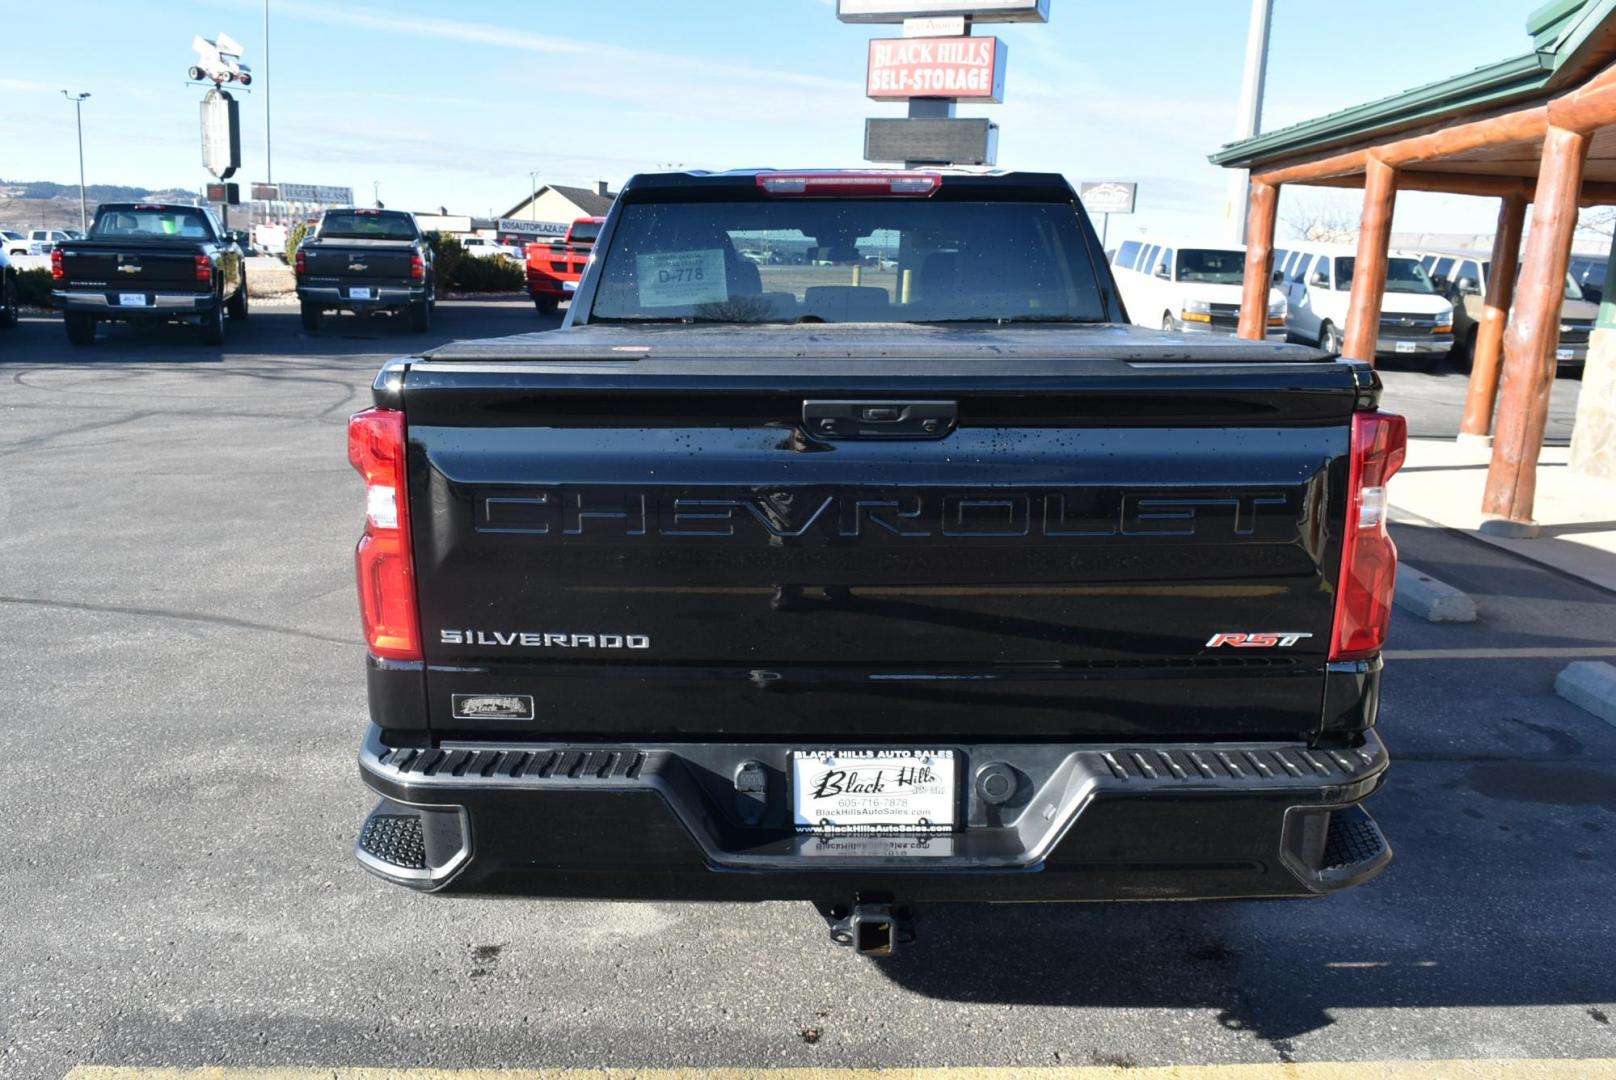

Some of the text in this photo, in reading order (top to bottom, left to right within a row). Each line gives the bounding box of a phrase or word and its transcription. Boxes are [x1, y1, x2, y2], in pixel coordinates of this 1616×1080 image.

[874, 42, 990, 67] BLACK HILLS
[871, 68, 988, 90] SELF-STORAGE
[502, 222, 568, 233] 605AUTOPLAZA.CO
[659, 268, 704, 283] D-778
[474, 494, 1287, 536] CHEVROLET
[440, 629, 650, 649] SILVERADO
[1205, 633, 1313, 647] RST
[794, 750, 954, 759] BLACK HILLS AUTO SALES
[808, 766, 936, 799] Black Hills
[838, 798, 908, 807] 605-716-7878
[815, 808, 931, 816] BlackHillsAutoSales.com
